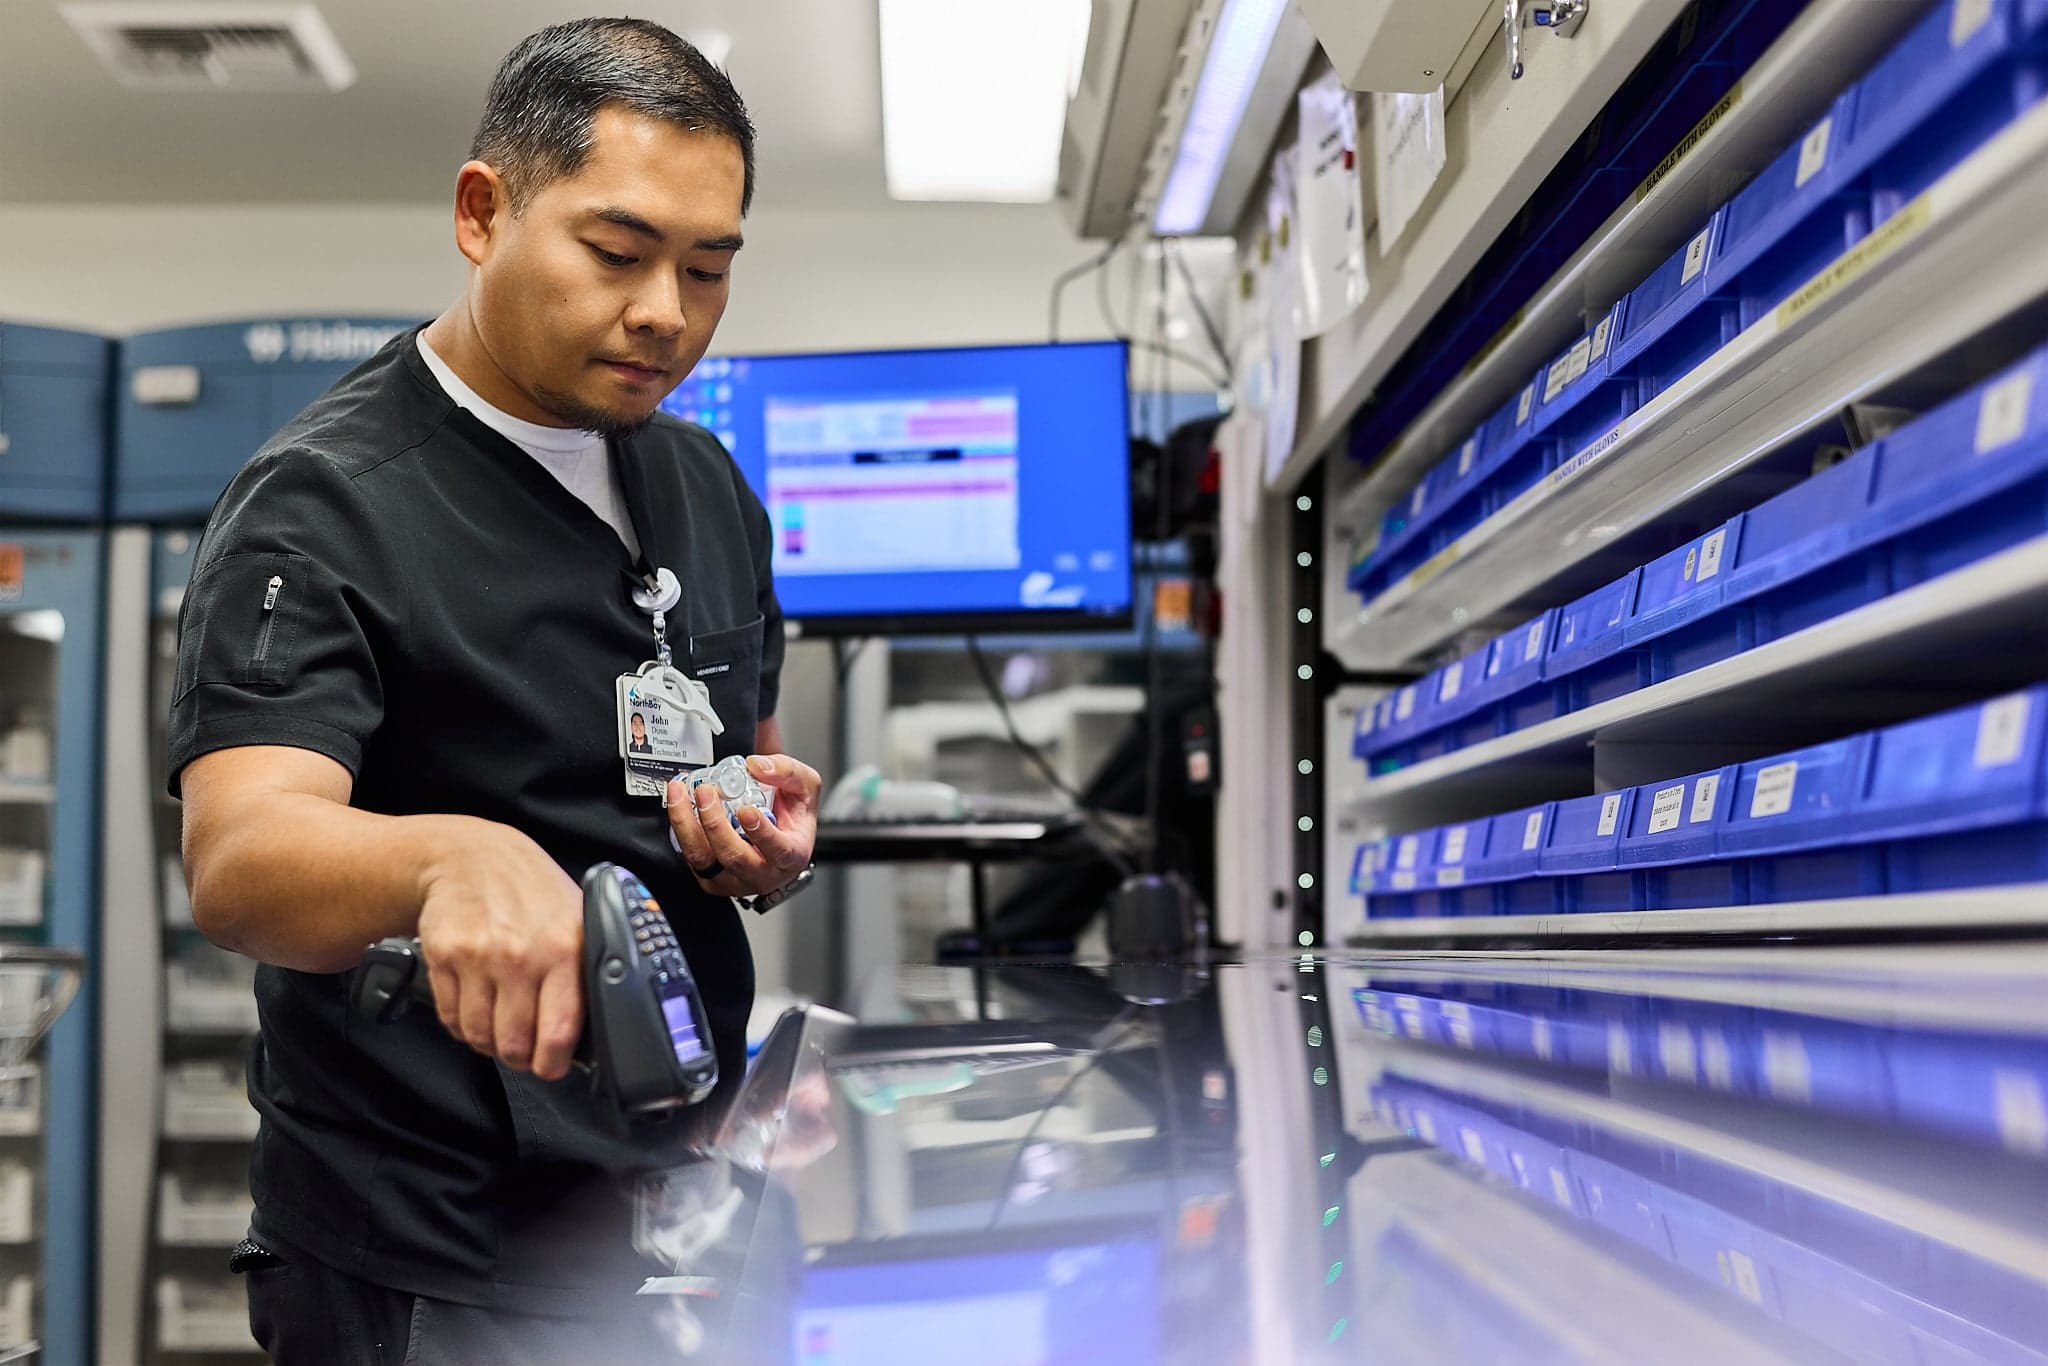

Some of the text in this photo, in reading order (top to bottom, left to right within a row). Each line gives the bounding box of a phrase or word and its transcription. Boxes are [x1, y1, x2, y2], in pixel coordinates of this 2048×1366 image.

[1646, 96, 1732, 192] HANDLE WITH GLOVES
[629, 698, 661, 711] NorthBay
[651, 715, 669, 726] John
[652, 736, 678, 748] Pharmacy
